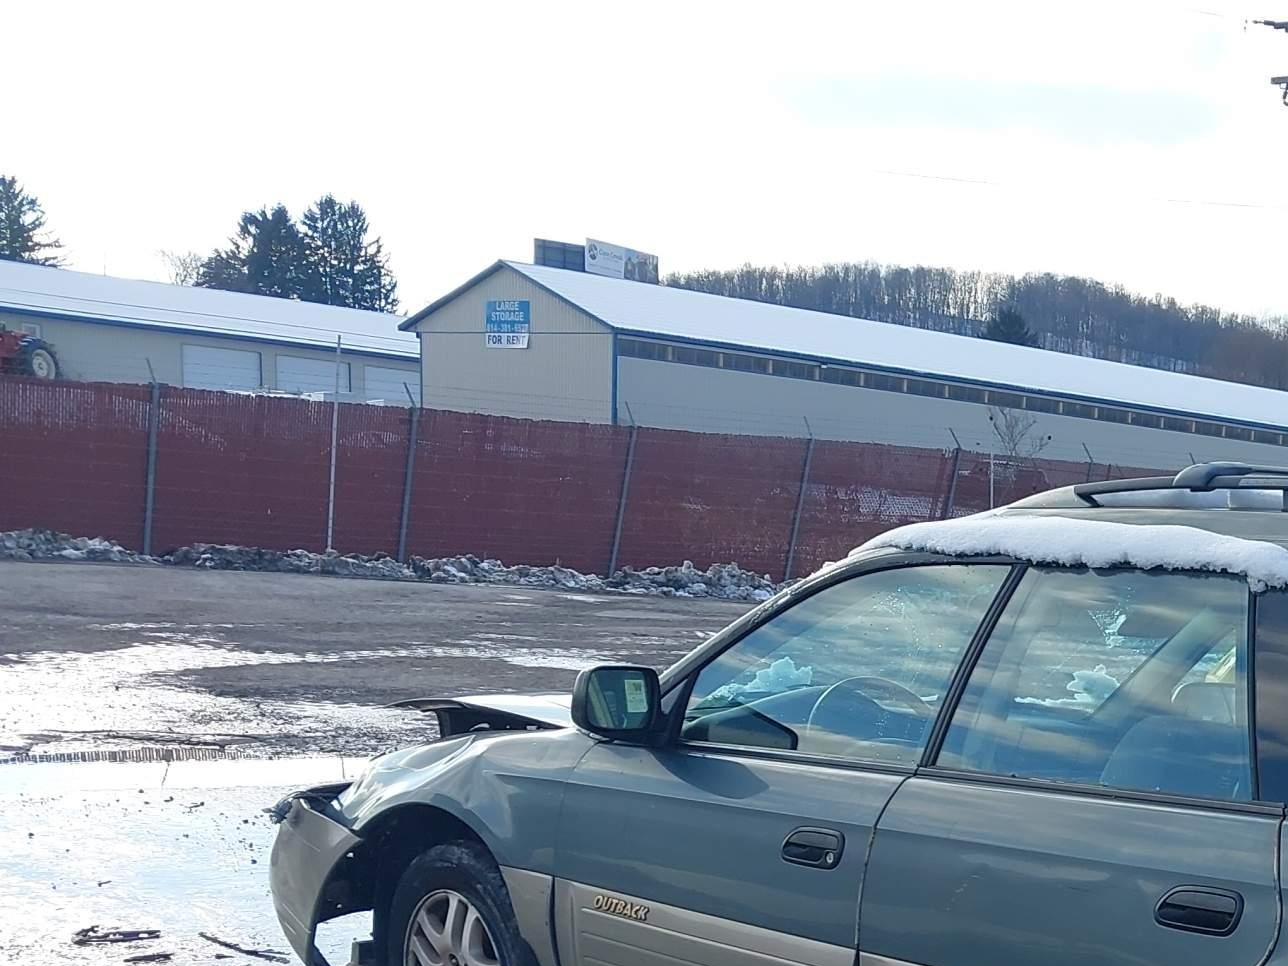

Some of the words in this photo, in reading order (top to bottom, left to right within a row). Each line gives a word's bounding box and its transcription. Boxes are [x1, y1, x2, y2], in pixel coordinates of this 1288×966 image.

[496, 301, 520, 311] LARGE
[491, 311, 525, 321] STORAGE
[487, 334, 503, 345] FOR
[506, 335, 526, 345] RENT
[593, 895, 650, 921] OUTBACK
